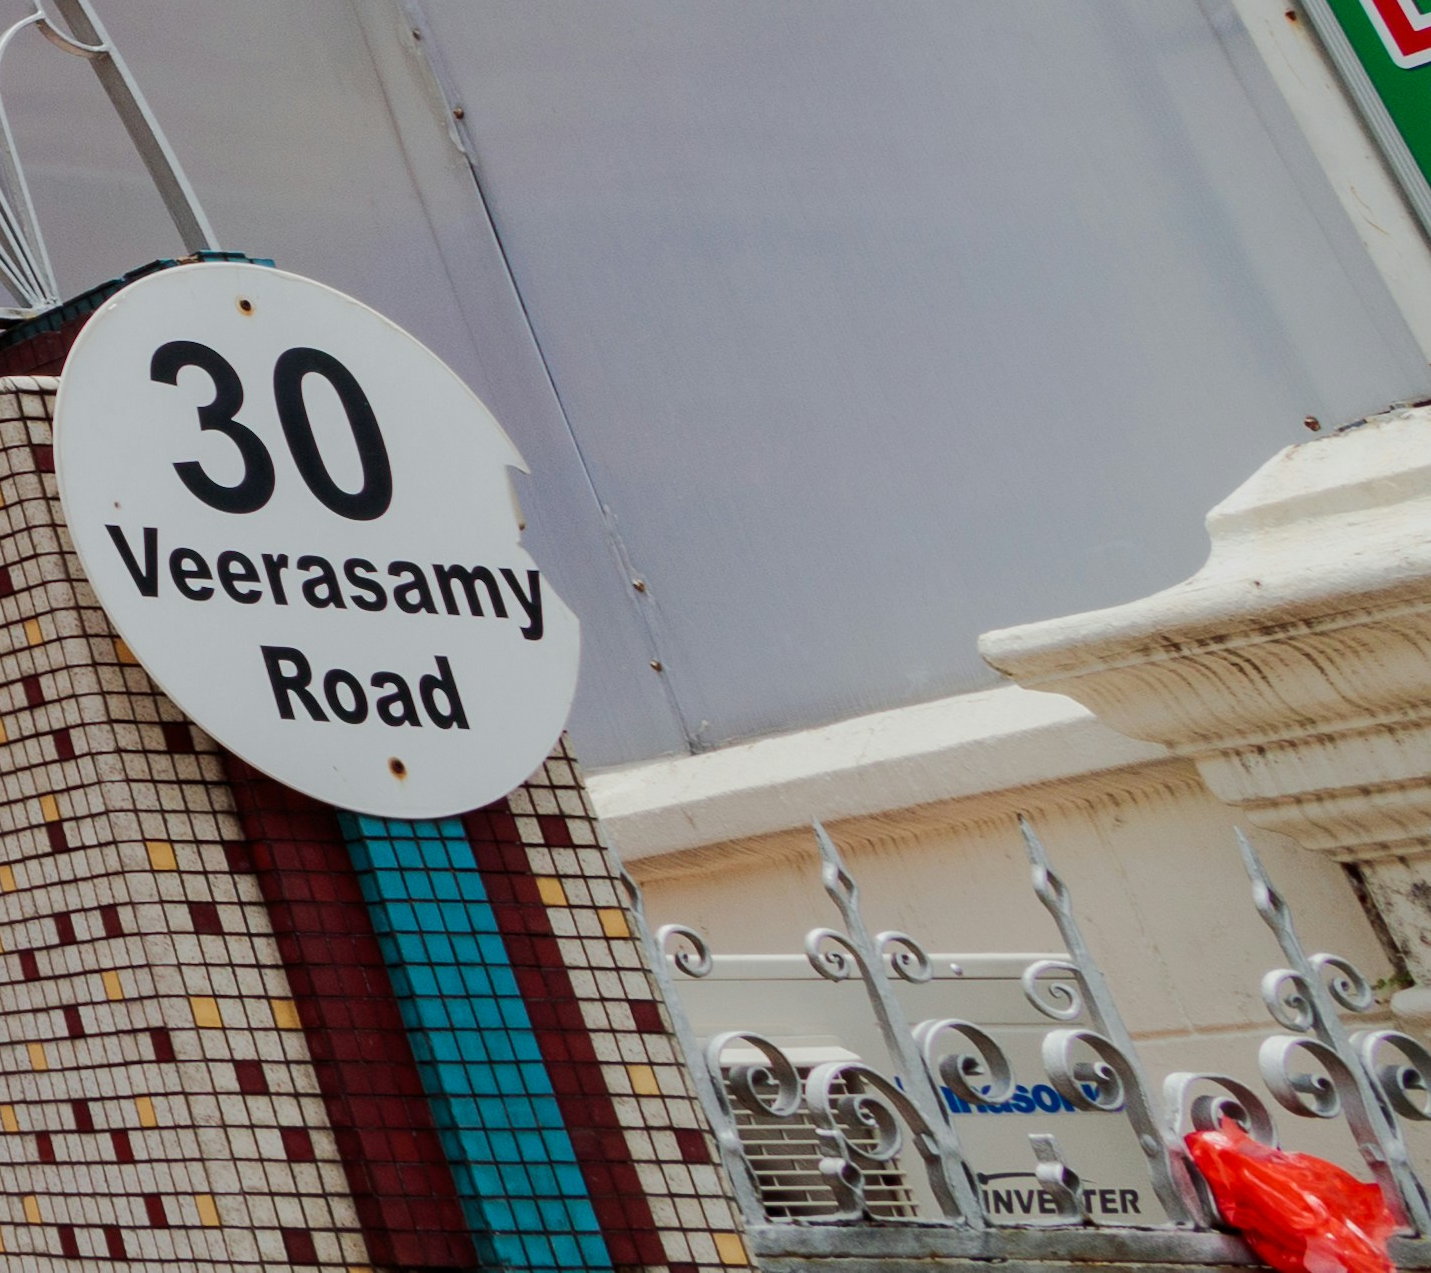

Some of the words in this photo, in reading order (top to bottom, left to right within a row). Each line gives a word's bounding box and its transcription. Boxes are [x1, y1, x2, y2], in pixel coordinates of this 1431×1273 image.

[151, 340, 393, 521] 30
[105, 524, 544, 641] Veerasamy
[260, 644, 471, 731] Road
[983, 1188, 1142, 1215] INVETER
